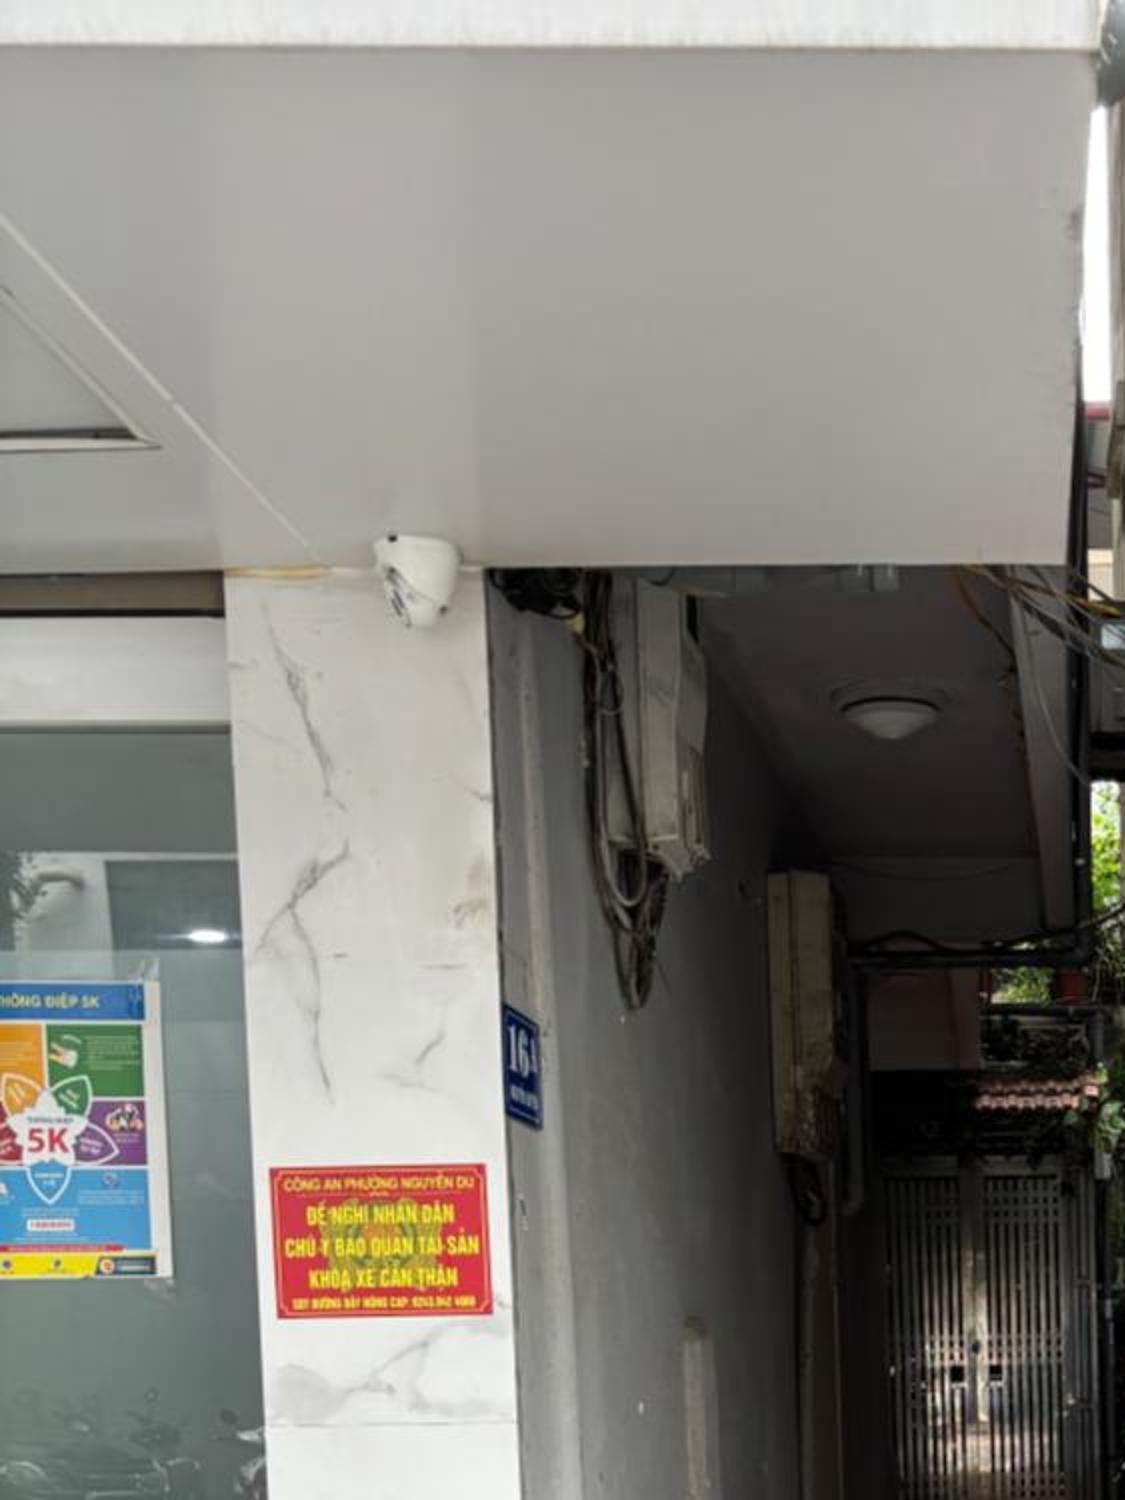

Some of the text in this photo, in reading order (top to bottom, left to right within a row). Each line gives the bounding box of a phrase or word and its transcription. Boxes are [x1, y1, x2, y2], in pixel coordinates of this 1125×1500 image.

[27, 1127, 69, 1153] 5K
[283, 1175, 321, 1192] CÔNG
[323, 1177, 342, 1191] AN
